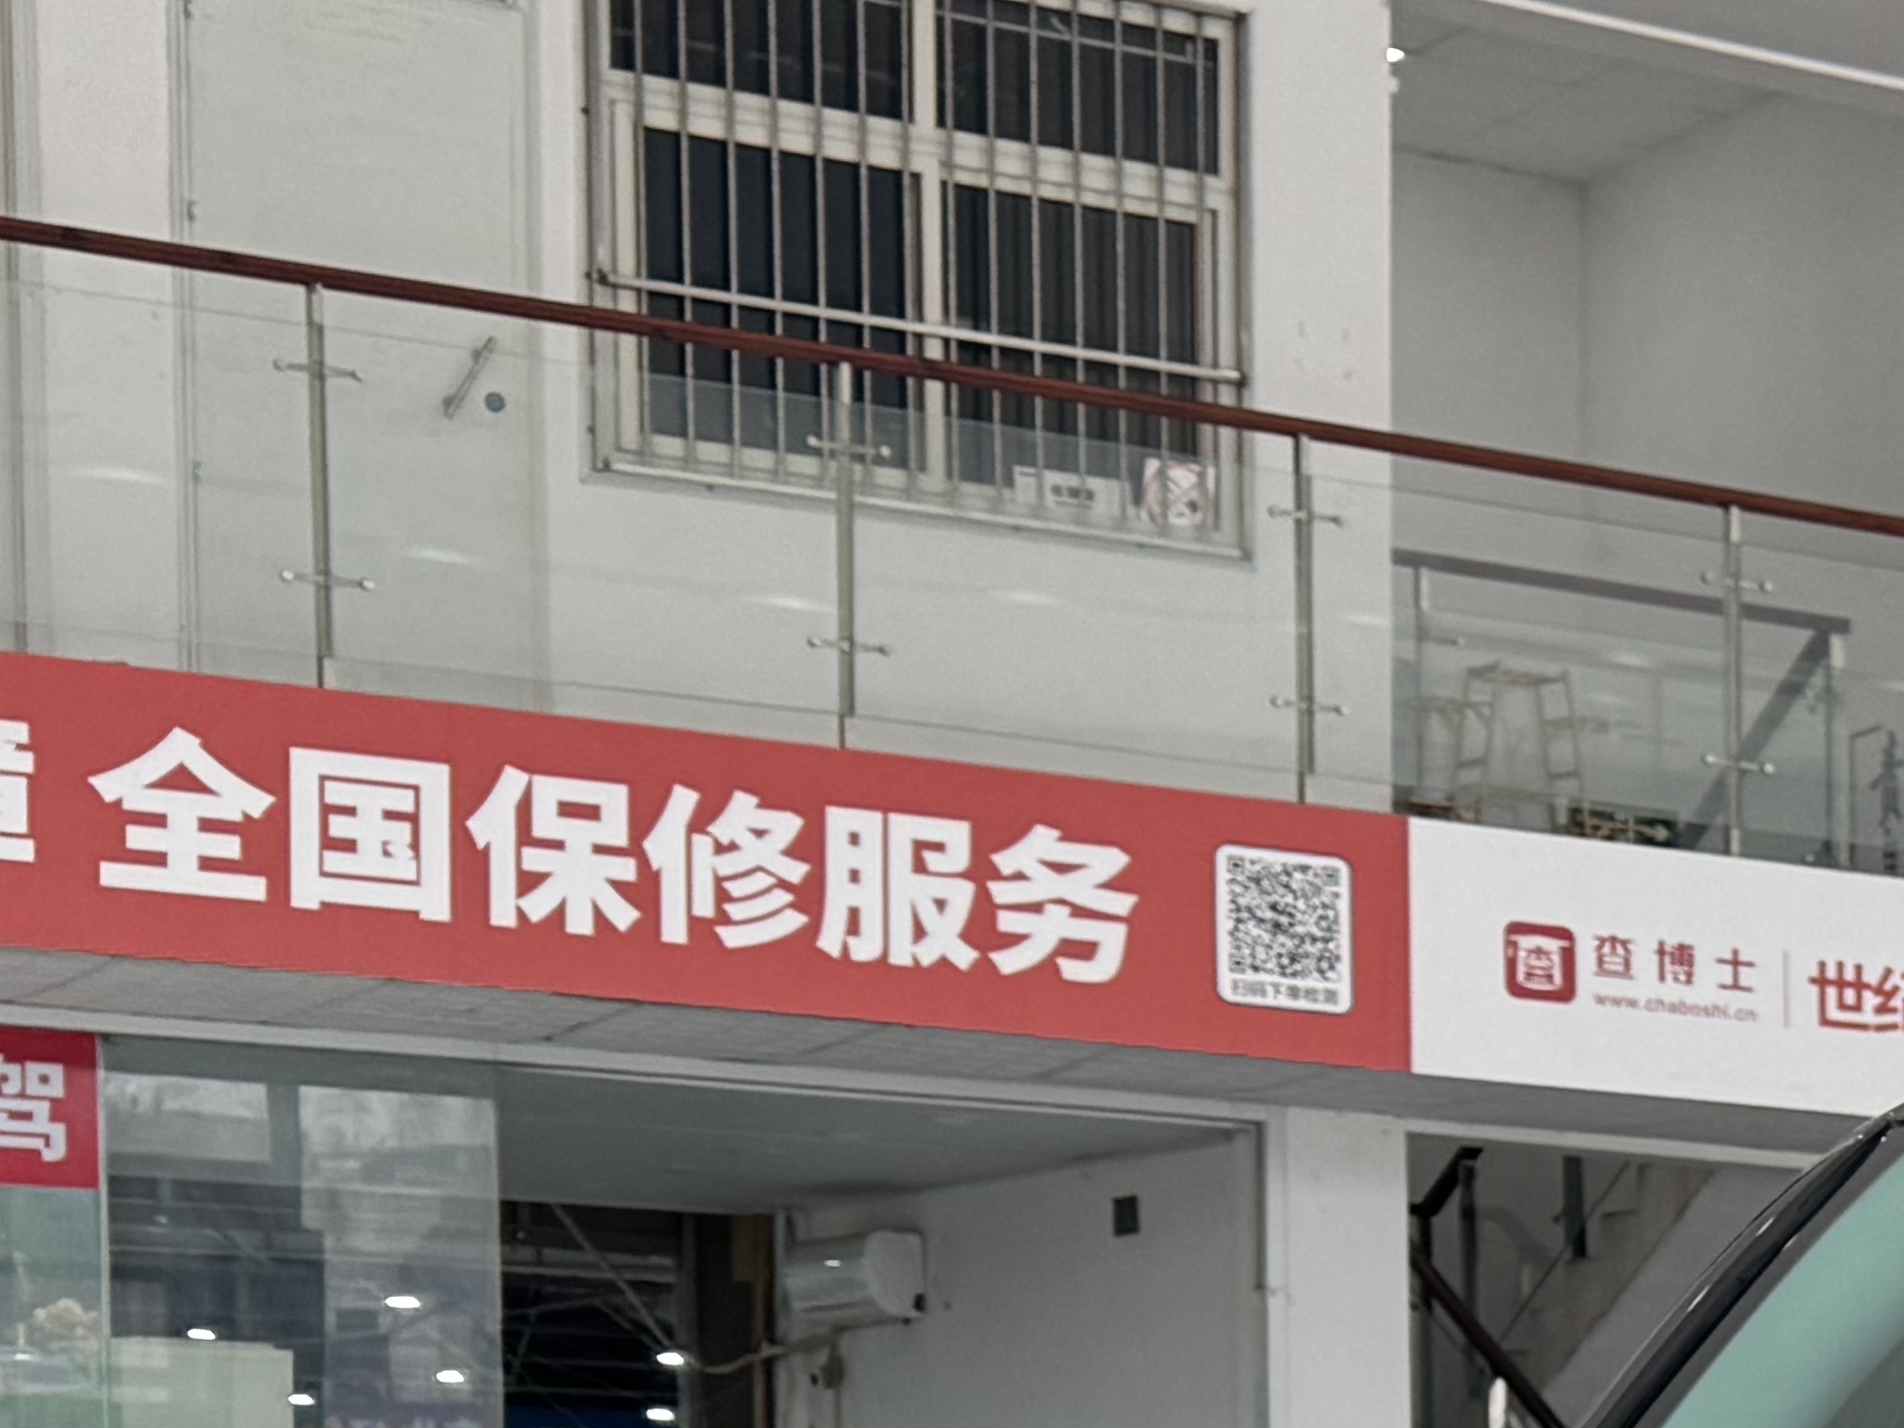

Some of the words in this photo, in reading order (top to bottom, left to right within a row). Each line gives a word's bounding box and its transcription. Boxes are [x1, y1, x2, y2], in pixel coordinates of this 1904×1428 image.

[87, 725, 1140, 985] 全国保修服务
